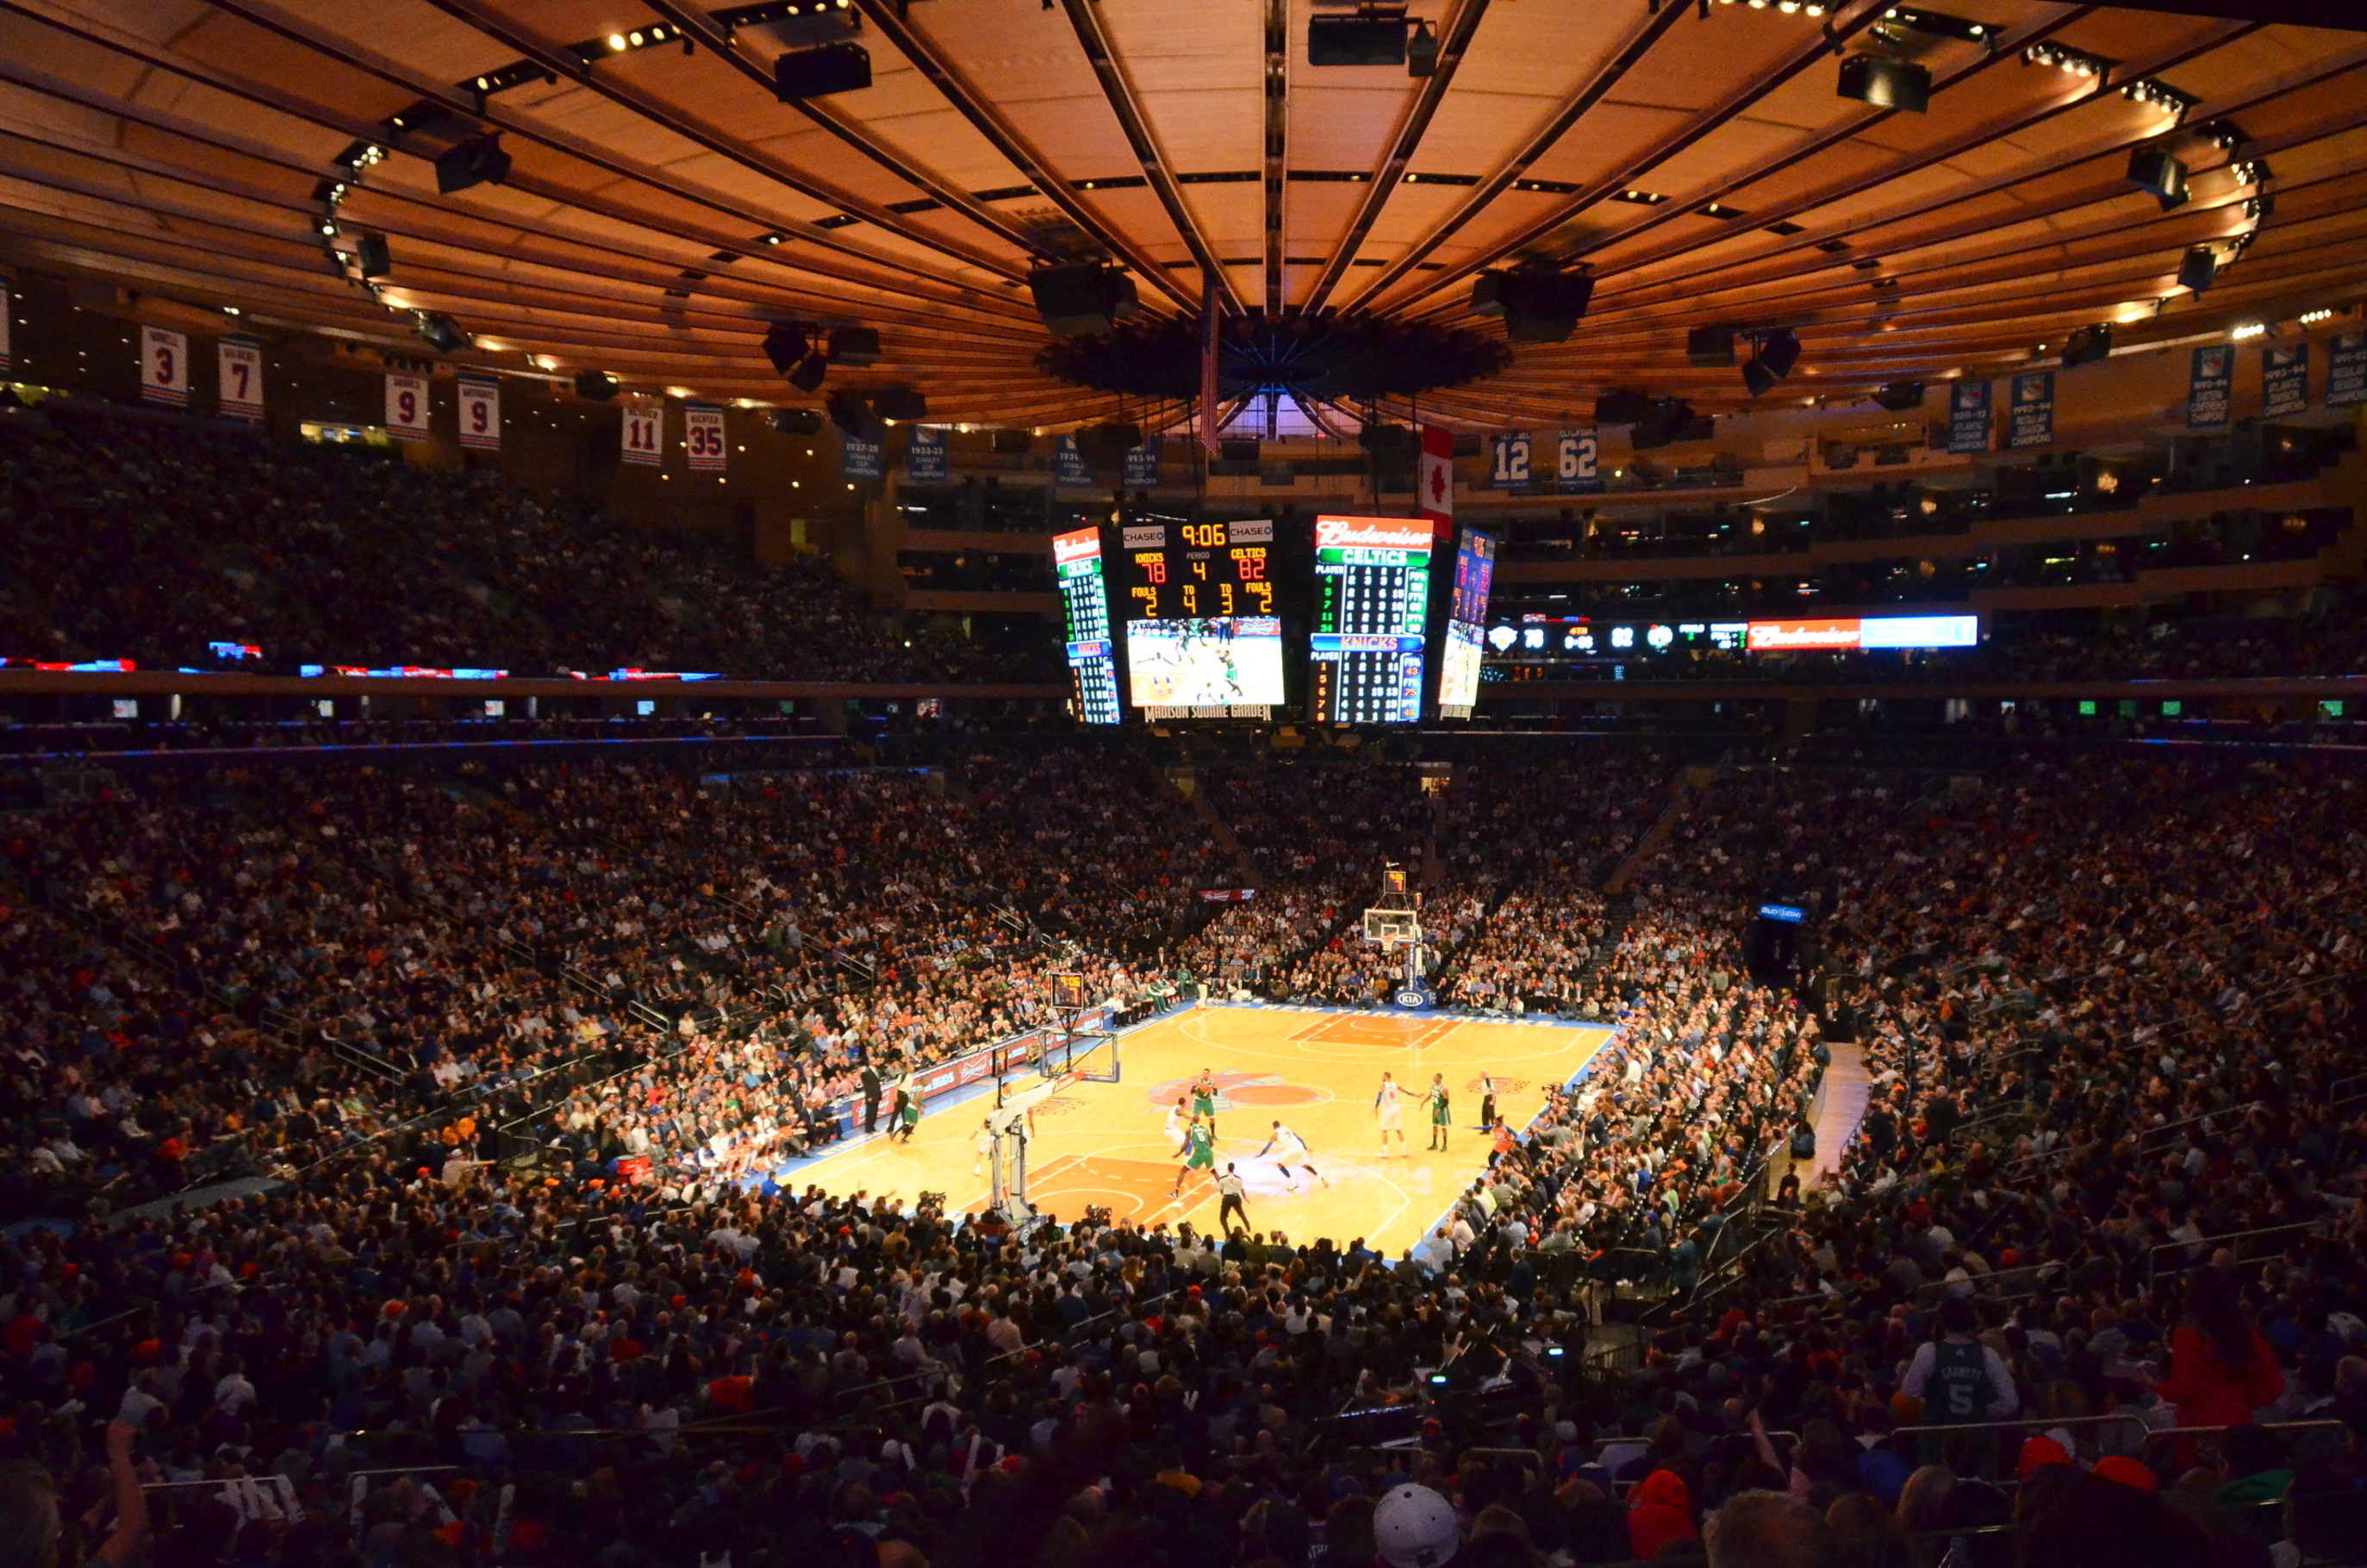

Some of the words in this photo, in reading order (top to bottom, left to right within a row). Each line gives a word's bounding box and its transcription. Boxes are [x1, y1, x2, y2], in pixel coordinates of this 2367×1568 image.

[156, 348, 172, 384] 3
[232, 363, 249, 399] 7
[400, 391, 414, 423] 9
[471, 401, 487, 432] 9
[630, 419, 654, 450] 11
[690, 426, 721, 456] 35
[1495, 441, 1529, 480] 12
[1560, 439, 1597, 477] 62
[1124, 532, 1155, 542] CHASE
[1183, 524, 1225, 546] 9:06
[1230, 527, 1264, 537] CHASE
[1316, 521, 1433, 545] Budweiser
[1135, 552, 1164, 563] KNICKS
[1187, 551, 1210, 560] PERIOD
[1230, 547, 1266, 560] CELTICS
[1342, 549, 1407, 566] CELTICS
[1067, 560, 1093, 577] CELTICS
[1142, 563, 1165, 583] 78
[1193, 562, 1205, 581] 4
[1239, 558, 1265, 579] 82
[1316, 565, 1344, 575] PLAYER
[1325, 575, 1332, 583] 4
[1348, 576, 1355, 585] 2
[1364, 576, 1371, 585] 3
[1380, 576, 1387, 586] 3
[1131, 587, 1157, 598] FOULS
[1183, 585, 1195, 595] TO
[1220, 583, 1232, 594] TO
[1246, 582, 1272, 594] FOULS
[1324, 588, 1331, 596] 5
[1347, 588, 1355, 598] 2
[1364, 588, 1370, 598] 1
[1379, 588, 1386, 599] 6
[1392, 589, 1405, 599] 15
[1146, 596, 1157, 617] 2
[1183, 595, 1196, 614] 4
[1222, 594, 1233, 613] 3
[1261, 592, 1273, 613] 2
[1324, 600, 1331, 609] 7
[1347, 600, 1355, 610] 2
[1378, 601, 1386, 611] 3
[1346, 613, 1352, 622] 1
[1361, 613, 1370, 623] 2
[1378, 613, 1386, 623] 2
[1320, 624, 1333, 632] 34
[1345, 625, 1353, 633] 4
[1361, 625, 1369, 633] 5
[1377, 625, 1385, 634] 2
[1390, 625, 1403, 634] 15
[1569, 626, 1588, 636] 4TH
[1689, 632, 1694, 640] 2
[1749, 626, 1861, 646] Budweiser
[1341, 636, 1398, 650] KNICKS
[1524, 629, 1544, 648] 78
[1611, 627, 1633, 647] 82
[1078, 642, 1101, 656] KNICKS
[1311, 651, 1339, 661] PLAYER
[1344, 652, 1350, 661] F
[1360, 652, 1367, 661] A
[1392, 652, 1398, 661] P
[1321, 663, 1326, 671] 1
[1344, 663, 1349, 672] 1
[1359, 663, 1367, 672] 2
[1375, 663, 1381, 672] 1
[1388, 663, 1398, 672] 11
[1320, 675, 1327, 683] 5
[1343, 675, 1349, 684] 1
[1358, 675, 1366, 684] 5
[1374, 675, 1381, 684] 3
[1389, 675, 1396, 684] 3
[1318, 688, 1326, 696] 6
[1342, 688, 1348, 697] 1
[1358, 688, 1364, 697] 1
[1317, 700, 1325, 708] 7
[1341, 700, 1349, 709] 4
[1356, 700, 1364, 709] 4
[1373, 700, 1380, 709] 3
[1144, 706, 1189, 723] MADISON
[1192, 706, 1228, 719] SQUARE
[1231, 705, 1272, 722] GARDEN
[1317, 712, 1324, 721] 8
[1341, 712, 1348, 721] 3
[1356, 712, 1363, 721] 3
[1373, 712, 1378, 721] 1
[1394, 880, 1402, 891] 7
[1761, 906, 1778, 915] BUD
[1061, 976, 1081, 986] 9:06
[1068, 987, 1078, 1004] 7
[1259, 1005, 1324, 1013] NEW
[1336, 1009, 1415, 1018] YORK
[1430, 1014, 1554, 1027] KNICKS
[1084, 1017, 1099, 1030] BUDS
[932, 1072, 955, 1090] BUDS
[1389, 1091, 1396, 1099] 6
[1940, 1366, 1983, 1381] GARNETT
[1949, 1384, 1974, 1415] 5
